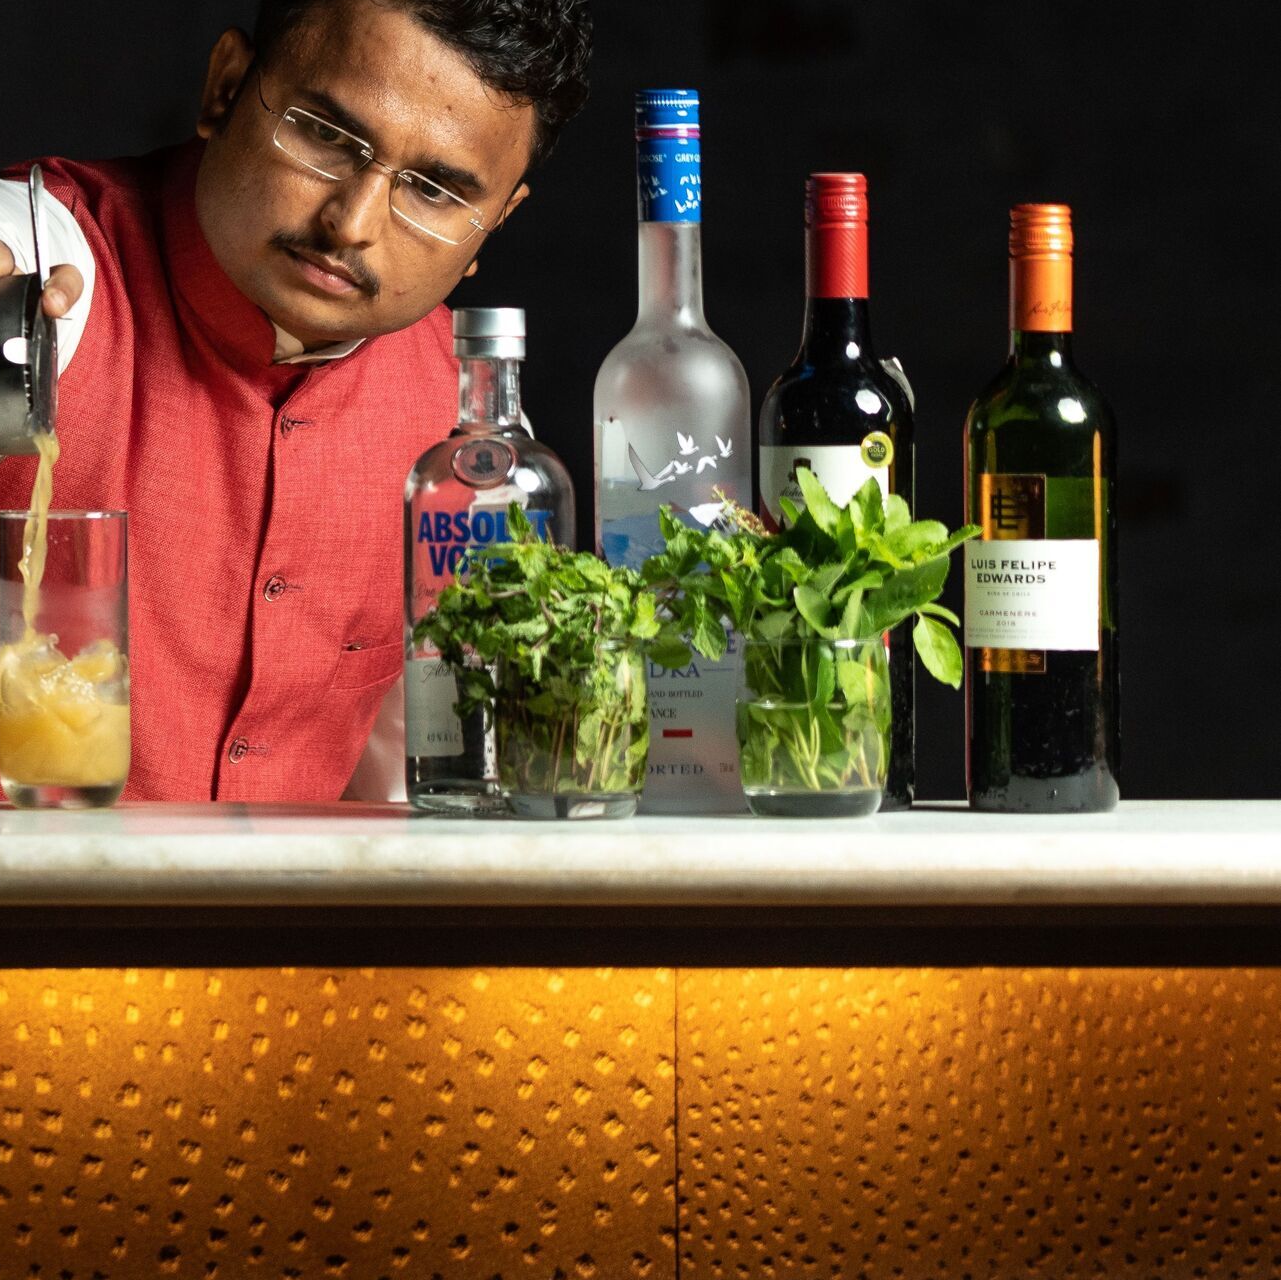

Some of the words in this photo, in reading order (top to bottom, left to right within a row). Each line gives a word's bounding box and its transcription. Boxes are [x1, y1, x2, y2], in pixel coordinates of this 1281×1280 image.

[418, 510, 554, 544] ABSOLT
[971, 559, 996, 570] LUIS
[1001, 559, 1057, 571] FELIPE
[976, 573, 1047, 584] EDWARDS
[649, 708, 677, 719] ANCE
